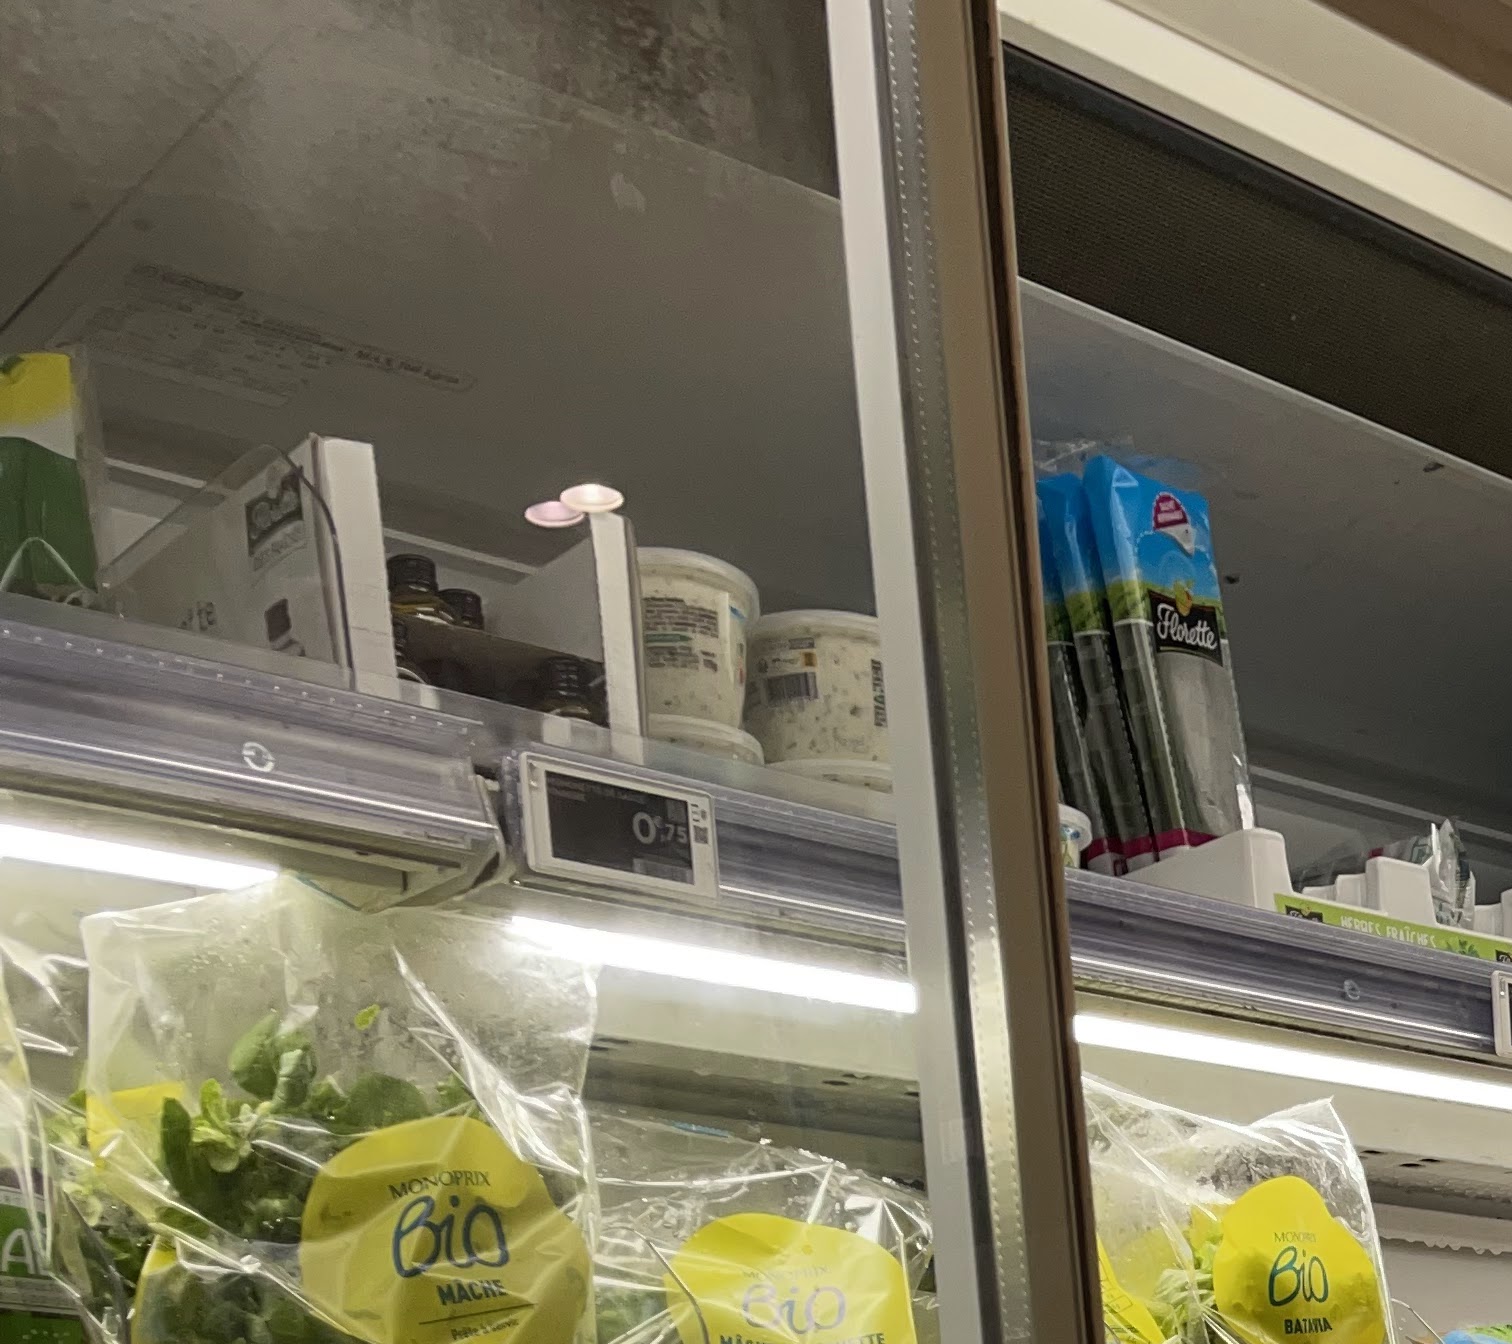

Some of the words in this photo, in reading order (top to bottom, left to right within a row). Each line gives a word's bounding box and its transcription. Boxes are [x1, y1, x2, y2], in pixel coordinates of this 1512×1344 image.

[1157, 602, 1217, 650] Florette
[388, 1170, 491, 1199] MONOPRIX
[435, 1279, 509, 1306] MÂCHE
[1284, 1316, 1332, 1335] BATAVIA
